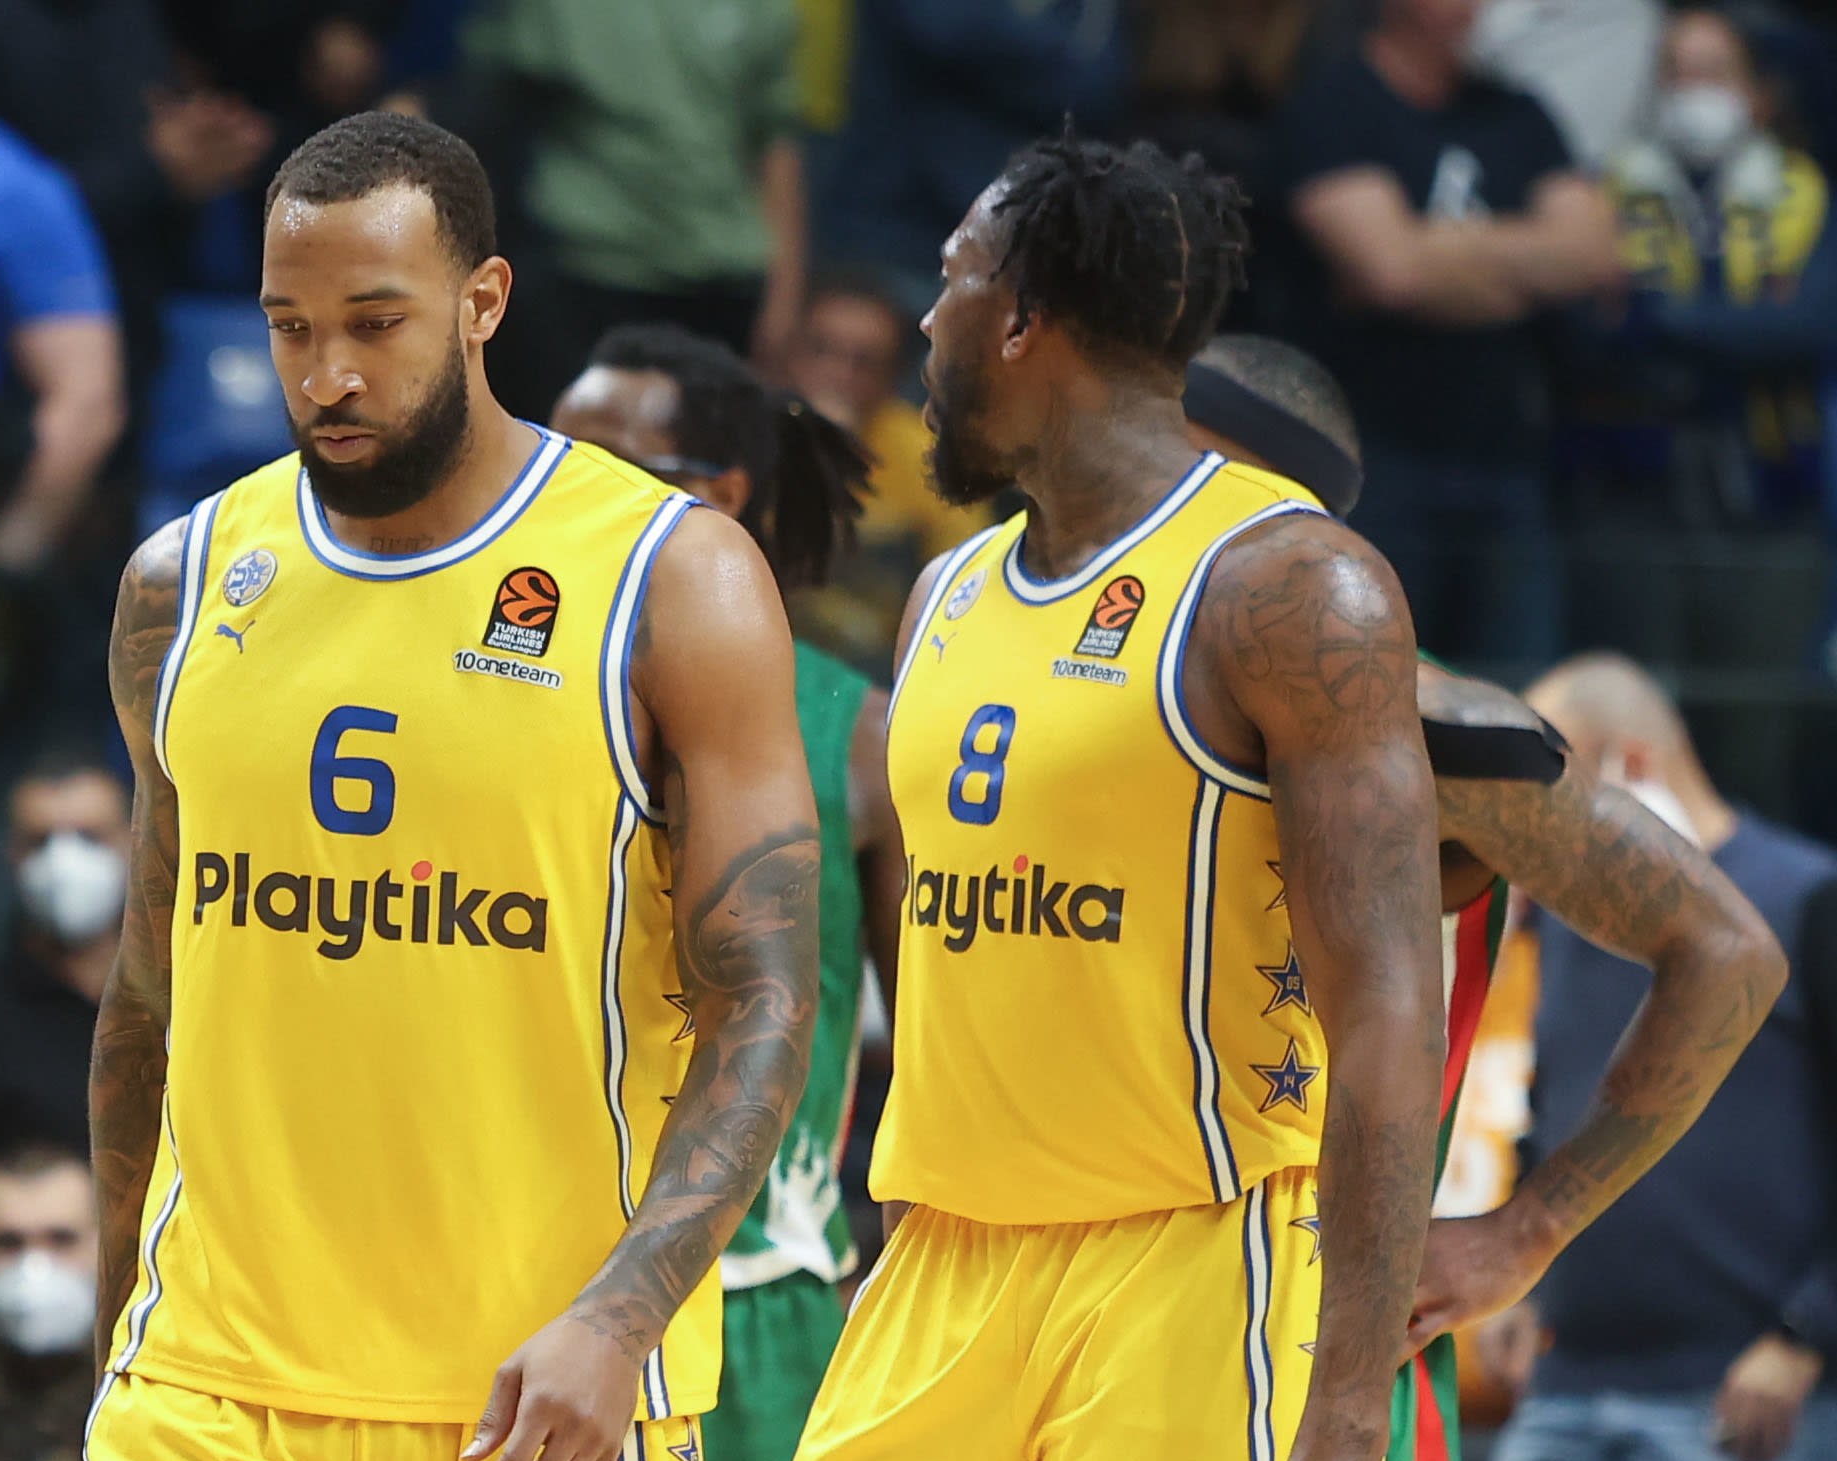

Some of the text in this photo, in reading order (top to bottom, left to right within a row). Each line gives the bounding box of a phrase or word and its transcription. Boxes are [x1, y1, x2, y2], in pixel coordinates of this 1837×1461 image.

[489, 631, 544, 650] AIRLINES
[494, 622, 546, 641] TURKISH
[310, 705, 399, 836] 6
[948, 704, 1016, 826] 8
[193, 852, 549, 961] Playtika
[908, 854, 1125, 953] laytika
